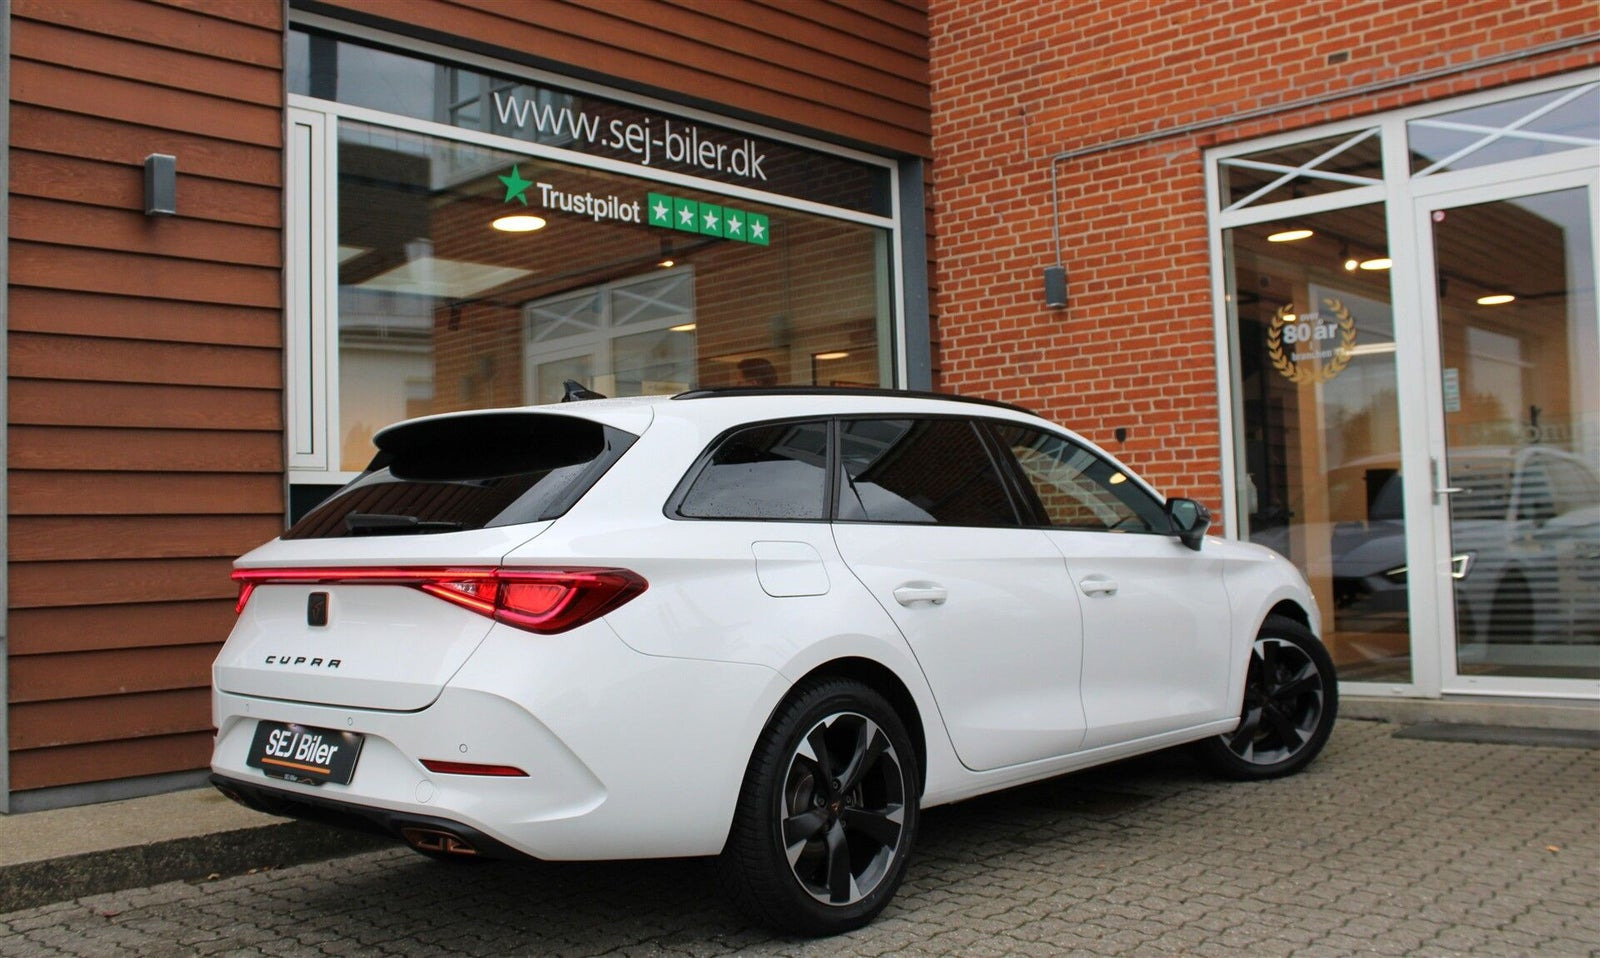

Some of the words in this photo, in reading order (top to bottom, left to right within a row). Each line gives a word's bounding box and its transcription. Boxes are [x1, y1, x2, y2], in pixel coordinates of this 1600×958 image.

[493, 92, 768, 181] www.sej-biler.dk
[536, 182, 641, 223] Trustpilot
[1283, 323, 1311, 344] 80
[1314, 319, 1338, 340] år
[265, 655, 342, 669] CUPRA
[265, 728, 299, 758] SEJ
[295, 733, 339, 766] Biler
